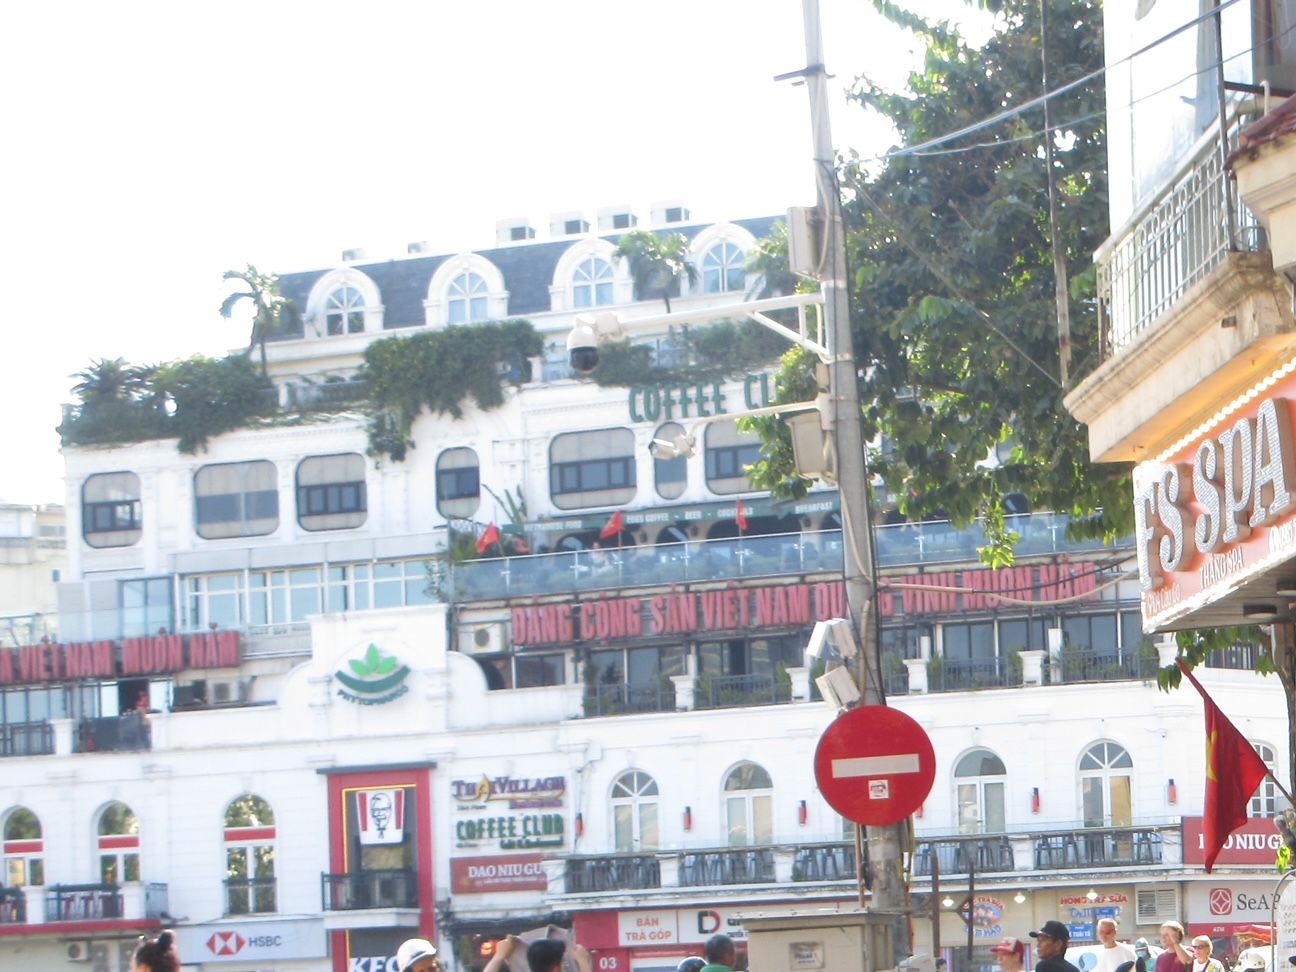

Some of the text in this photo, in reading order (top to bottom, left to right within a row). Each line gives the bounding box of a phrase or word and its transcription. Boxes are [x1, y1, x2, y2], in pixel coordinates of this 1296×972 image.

[629, 376, 727, 422] COFFEE
[1193, 398, 1291, 555] SPA
[755, 583, 810, 625] NAM
[903, 570, 957, 614] VINH
[65, 640, 115, 678] NAM
[457, 813, 564, 840] COFFEE CLUB
[1235, 833, 1266, 849] NIU
[468, 866, 497, 878] DAO
[498, 864, 522, 876] NIU
[249, 936, 282, 948] HSBC
[600, 957, 617, 969] 03
